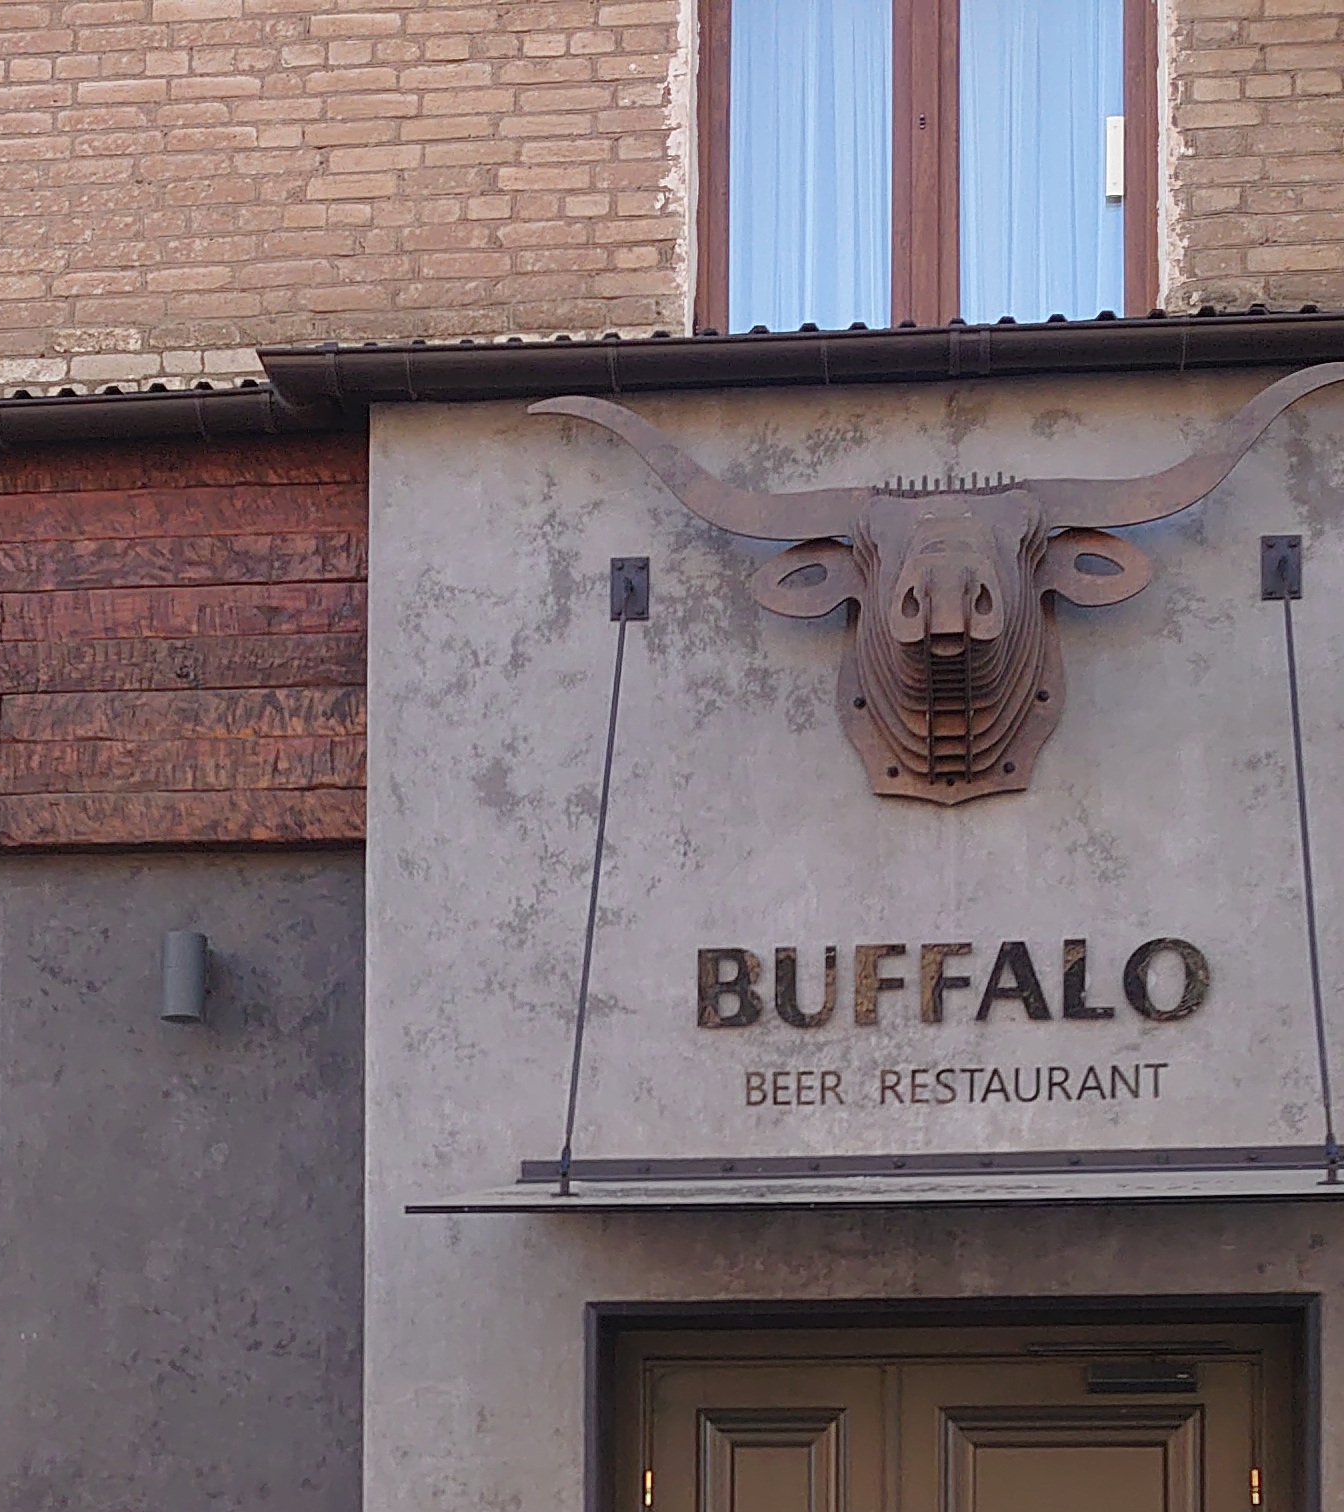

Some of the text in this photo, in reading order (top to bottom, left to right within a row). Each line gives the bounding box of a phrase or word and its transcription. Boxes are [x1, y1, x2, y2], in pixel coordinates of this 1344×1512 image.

[697, 937, 1211, 1028] BUFFALO
[744, 1063, 1169, 1106] BEER RESTAURANT
